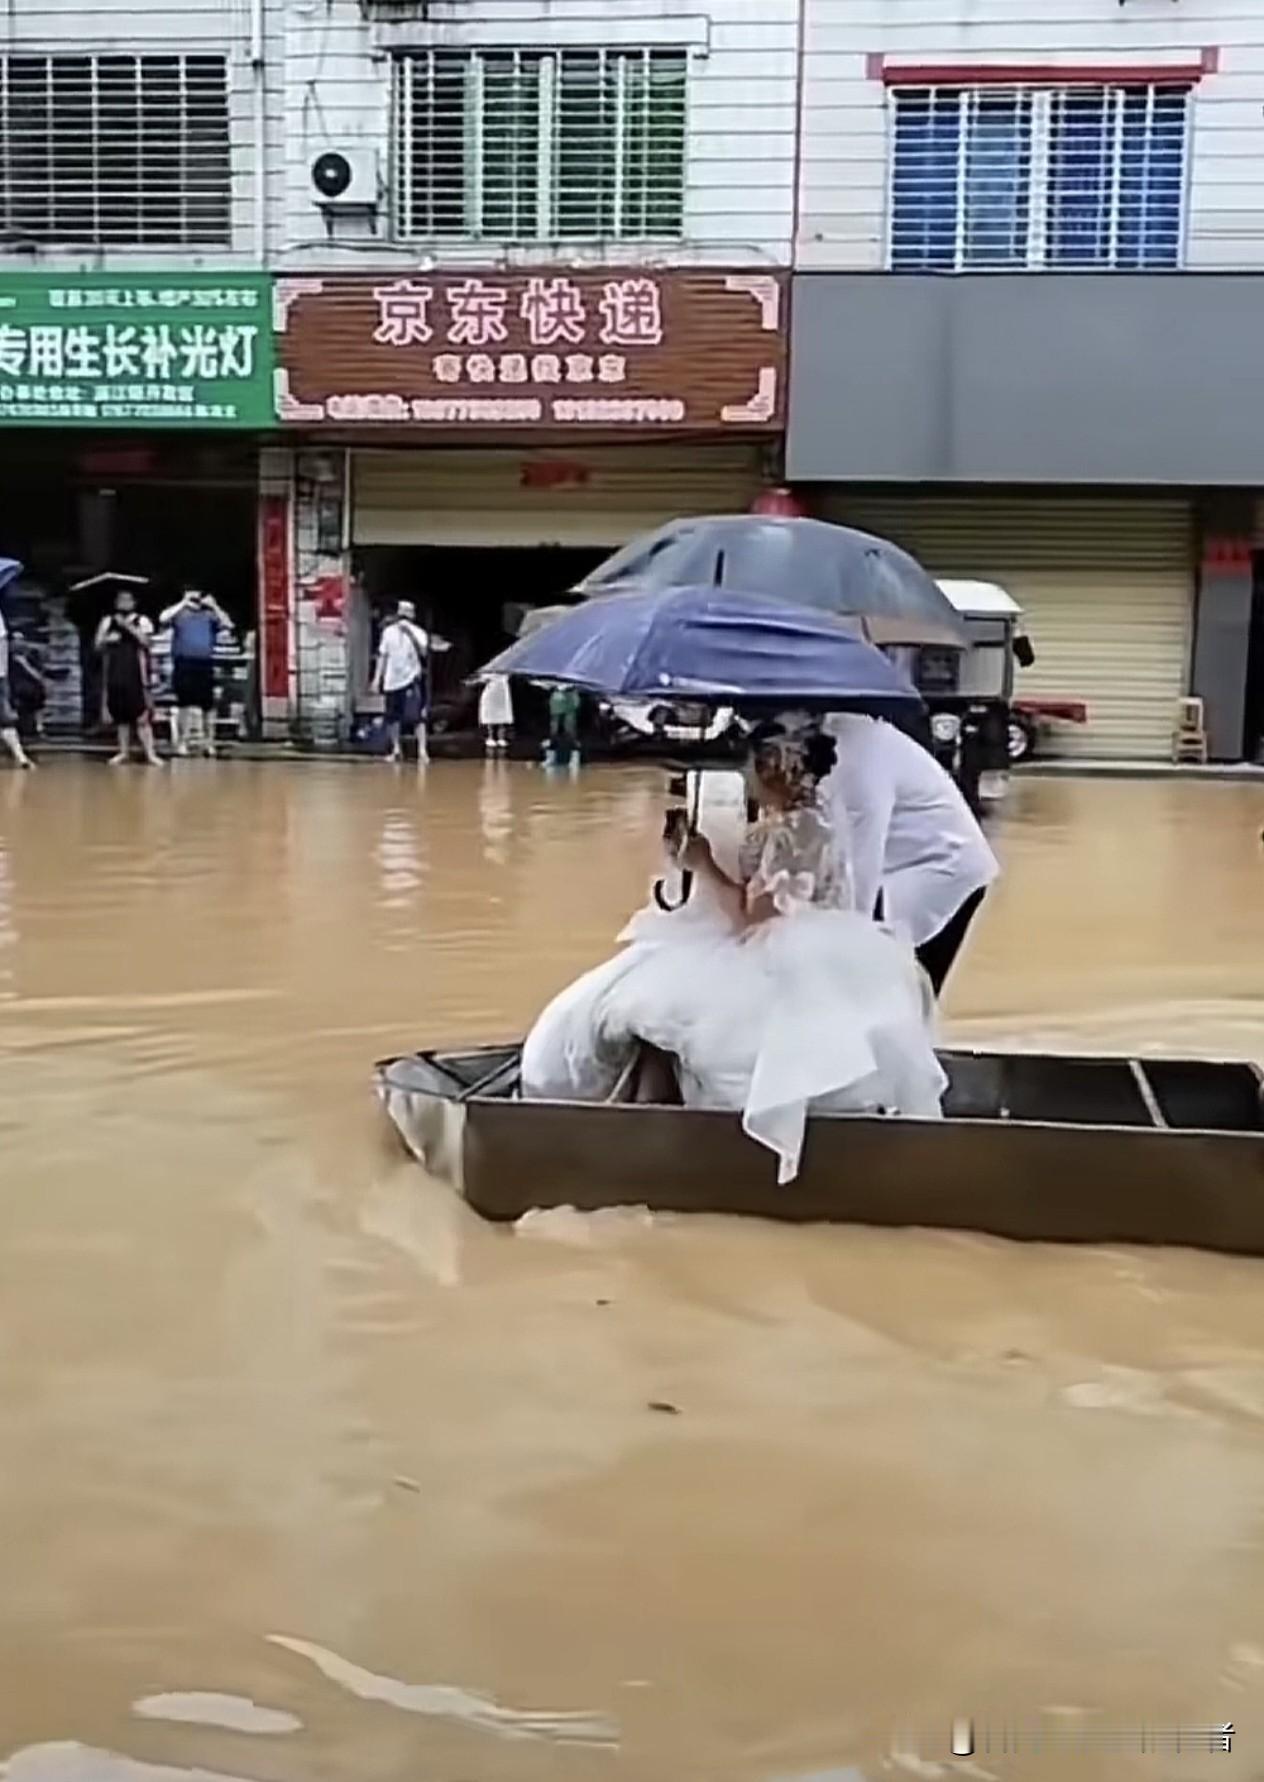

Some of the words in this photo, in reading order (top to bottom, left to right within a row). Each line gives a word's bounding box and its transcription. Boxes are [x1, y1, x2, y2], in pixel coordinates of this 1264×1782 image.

[373, 279, 662, 345] 京东快递
[0, 324, 258, 379] 专用生长补光灯
